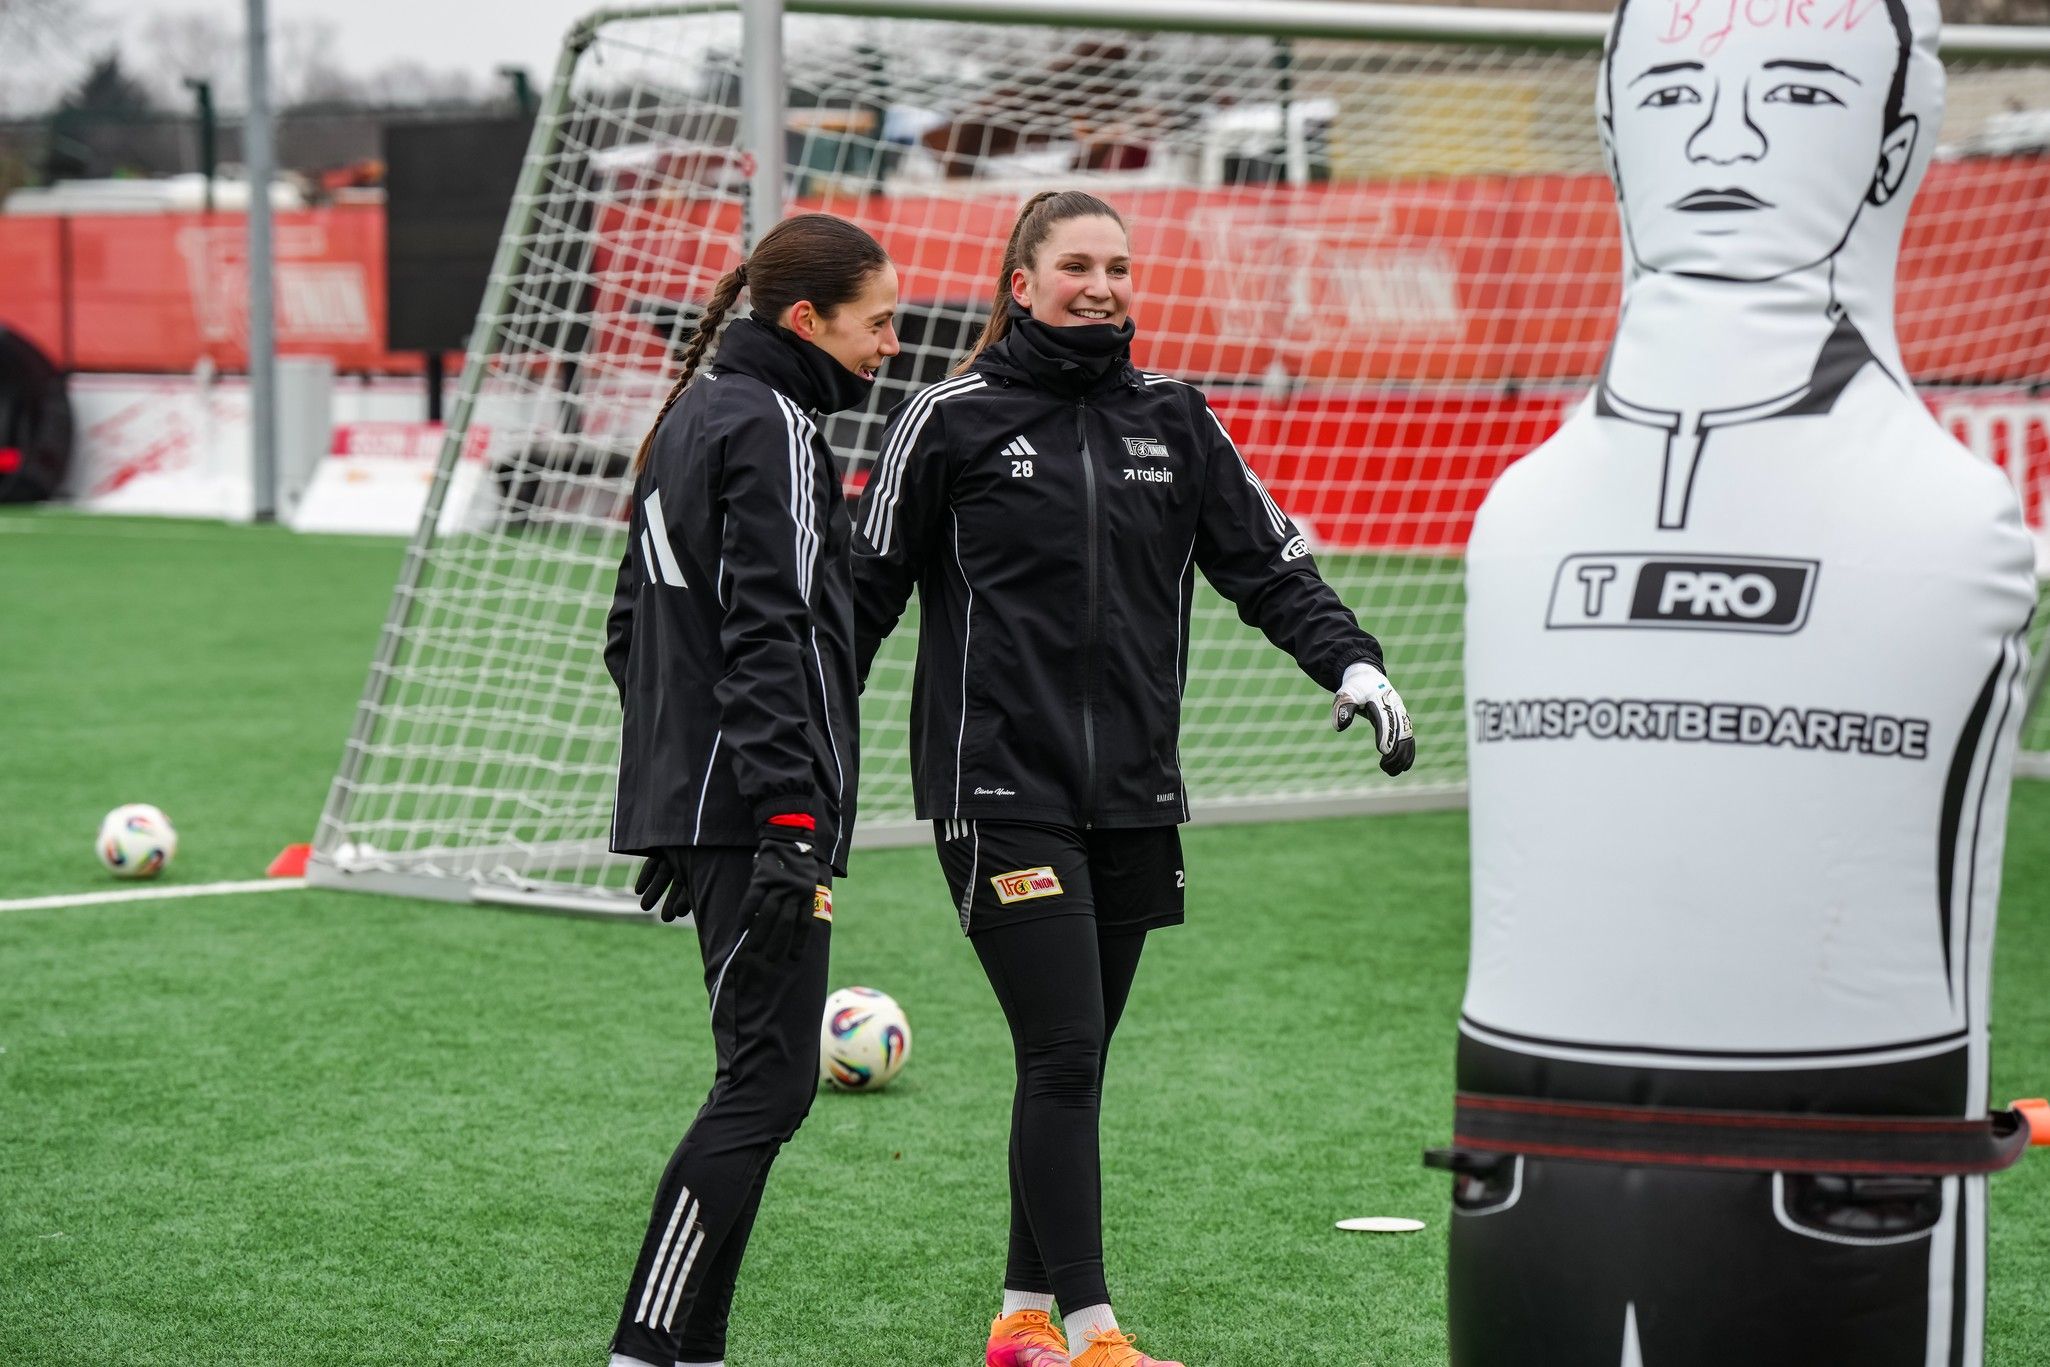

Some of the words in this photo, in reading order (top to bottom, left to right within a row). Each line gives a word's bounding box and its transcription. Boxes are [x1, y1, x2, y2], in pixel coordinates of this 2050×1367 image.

[1011, 460, 1034, 478] 28
[1136, 466, 1173, 483] raisin
[1577, 564, 1616, 617] T
[1657, 569, 1778, 619] PRO
[1474, 698, 1929, 760] TEAMSPORTBEDARF.DE
[1030, 877, 1054, 890] UNION
